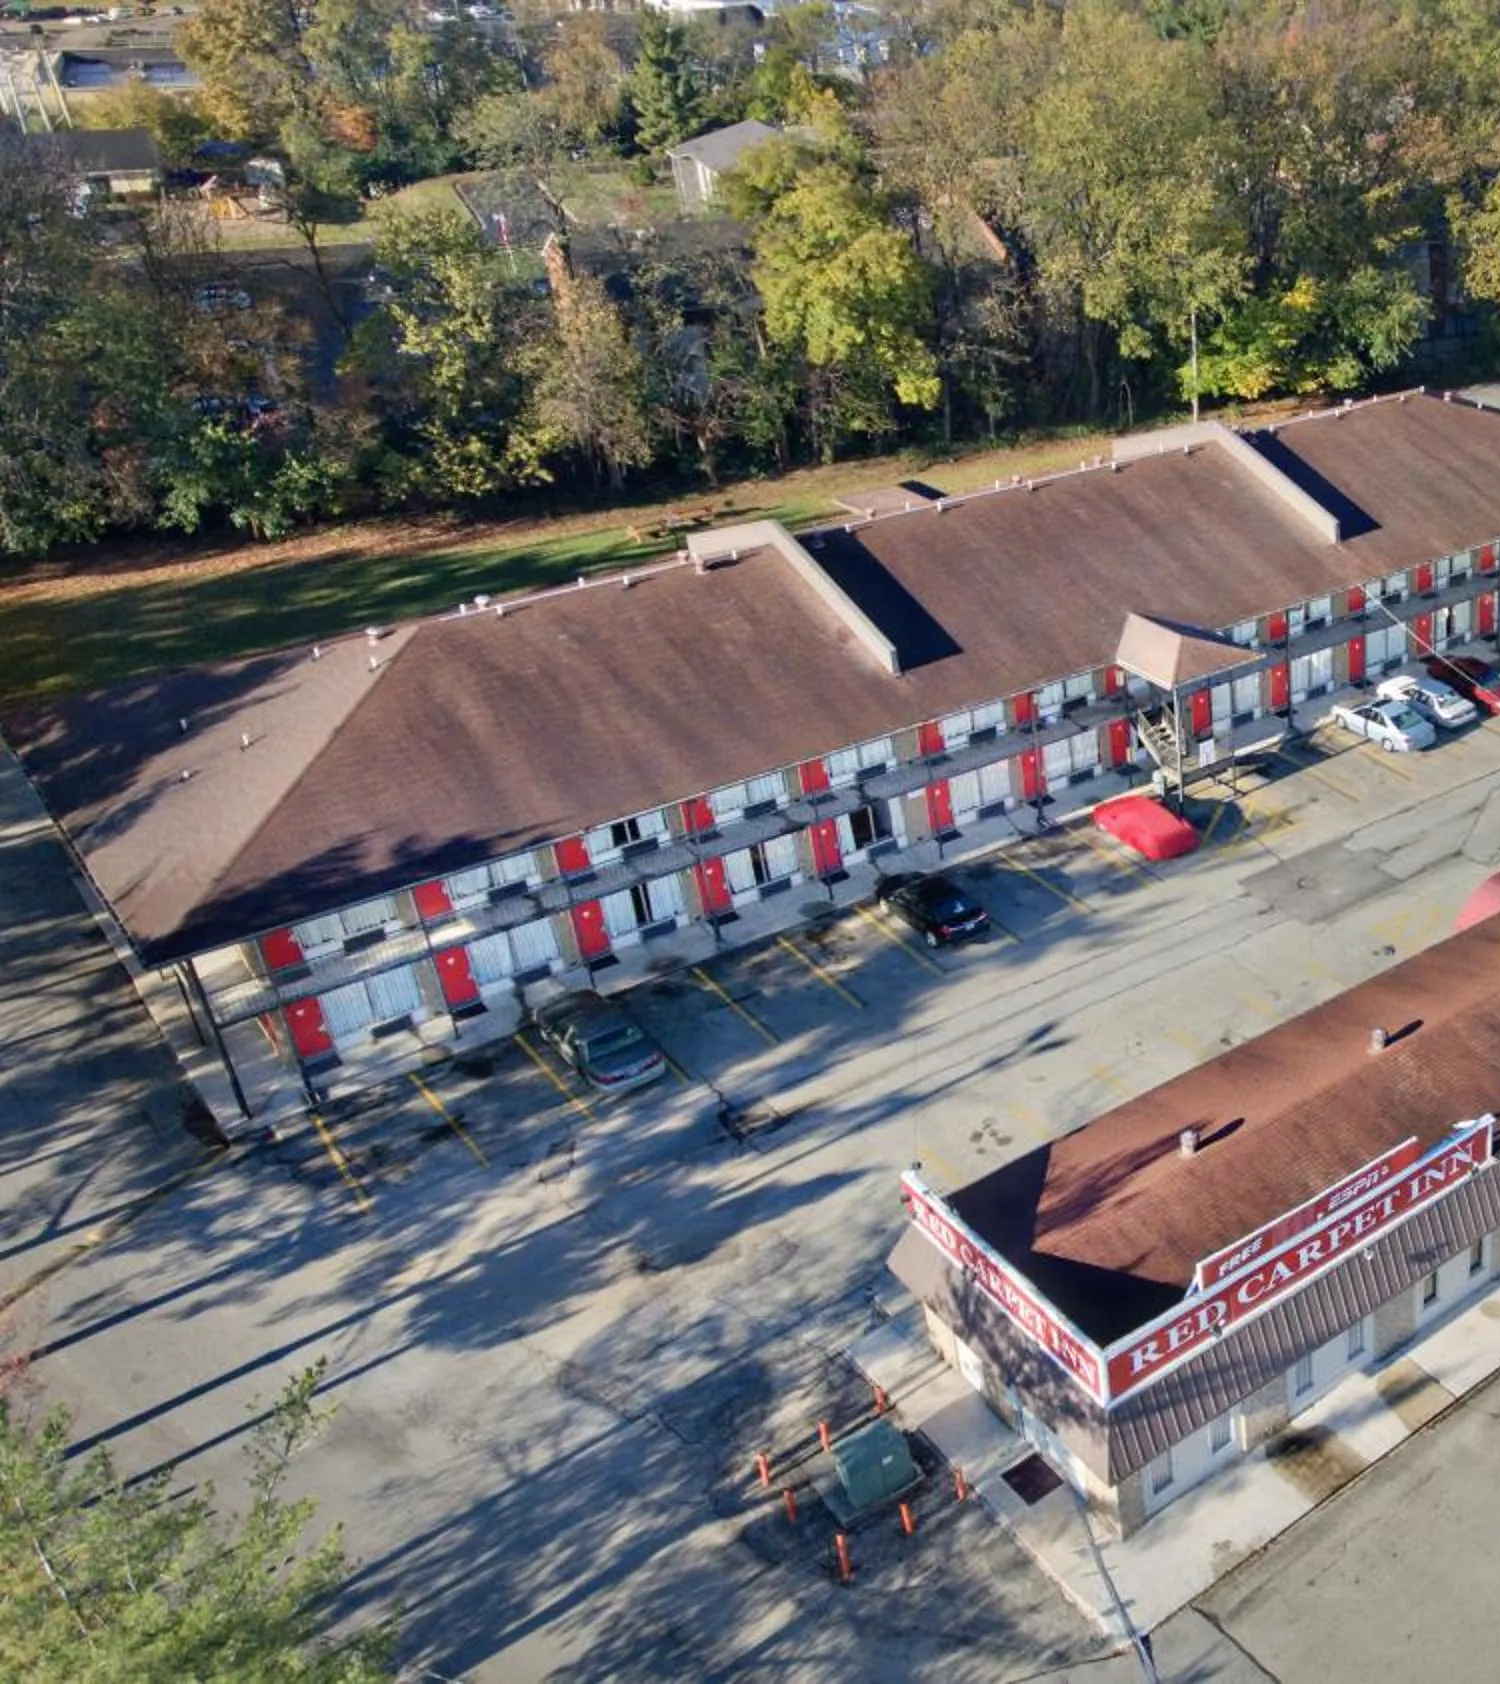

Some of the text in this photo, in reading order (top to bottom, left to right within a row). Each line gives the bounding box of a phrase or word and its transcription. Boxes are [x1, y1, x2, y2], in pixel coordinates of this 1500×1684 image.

[913, 1197, 956, 1249] RED
[958, 1244, 1046, 1335] CARPET
[1129, 1138, 1475, 1376] RED CARPET INN
[1218, 1170, 1379, 1277] FREE ESPN
